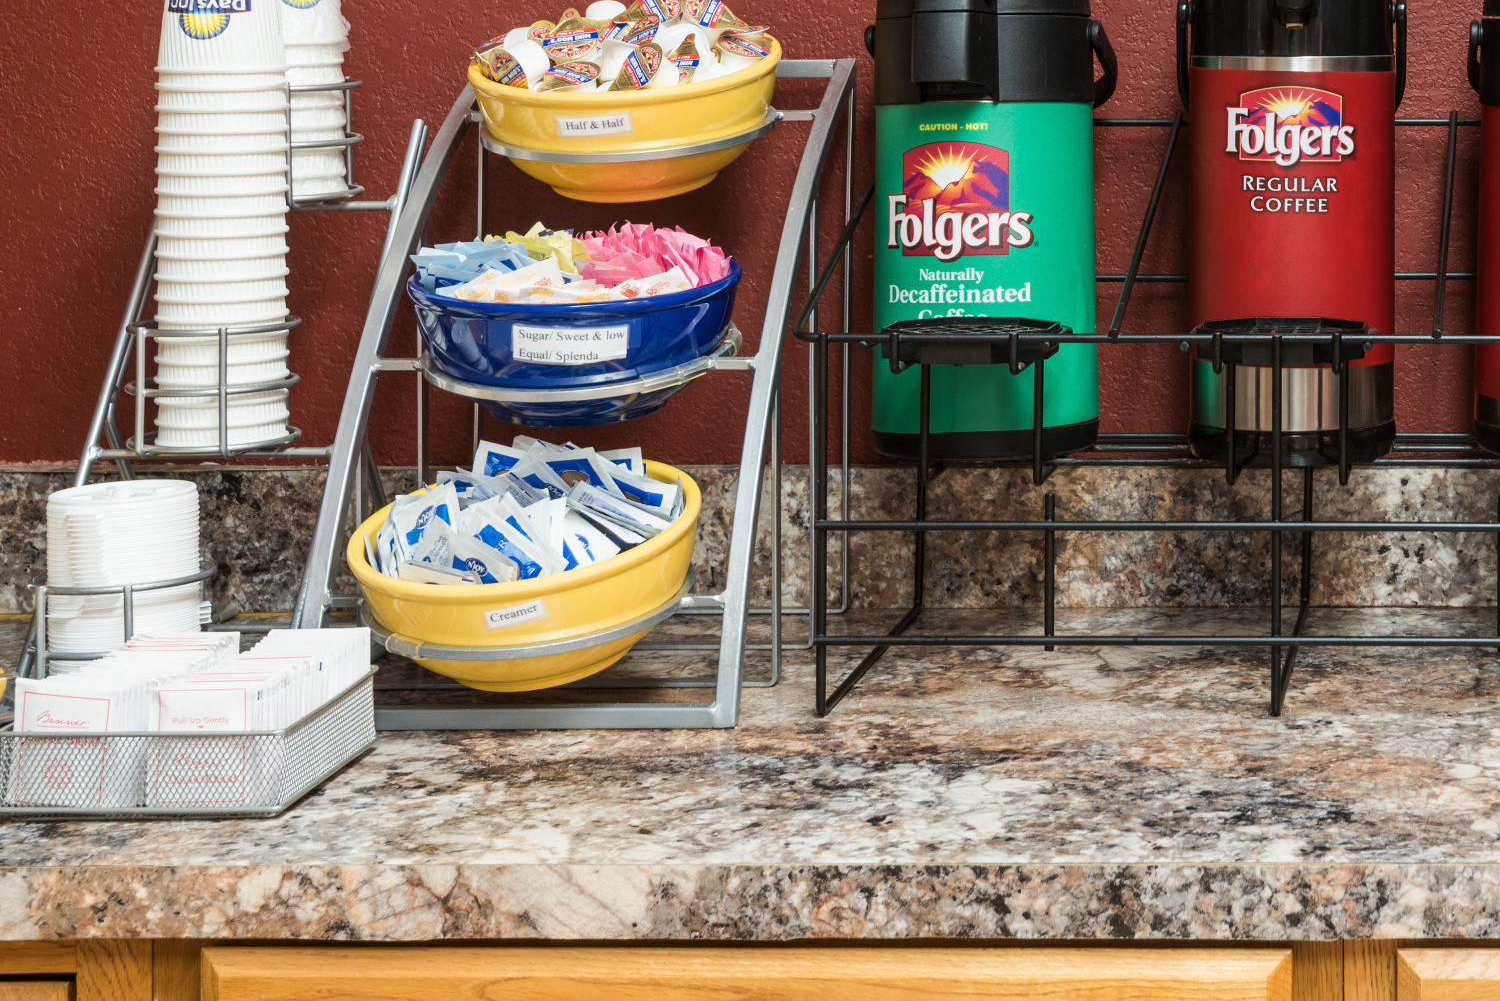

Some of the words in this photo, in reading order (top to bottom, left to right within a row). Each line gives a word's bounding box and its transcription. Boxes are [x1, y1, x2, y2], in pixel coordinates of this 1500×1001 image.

[565, 119, 587, 132] Half
[590, 119, 600, 131] &
[602, 117, 625, 130] Half
[919, 123, 958, 131] CAUTION
[965, 123, 988, 131] HOT!
[1225, 105, 1356, 167] Folgers
[1242, 175, 1338, 193] REGULAR
[1250, 195, 1328, 213] COFFEE
[887, 193, 1035, 262] Folgers
[918, 268, 984, 284] Naturally
[888, 283, 1031, 304] Decaffeinated
[518, 328, 554, 343] Sugar/
[556, 330, 589, 342] Sweet
[592, 330, 603, 342] &
[606, 329, 626, 340] low
[518, 348, 553, 362] Equal/
[556, 349, 599, 363] Splenda
[489, 601, 540, 624] Creamer
[172, 717, 188, 725] Pull
[190, 717, 201, 726] Up
[203, 716, 230, 726] Gently
